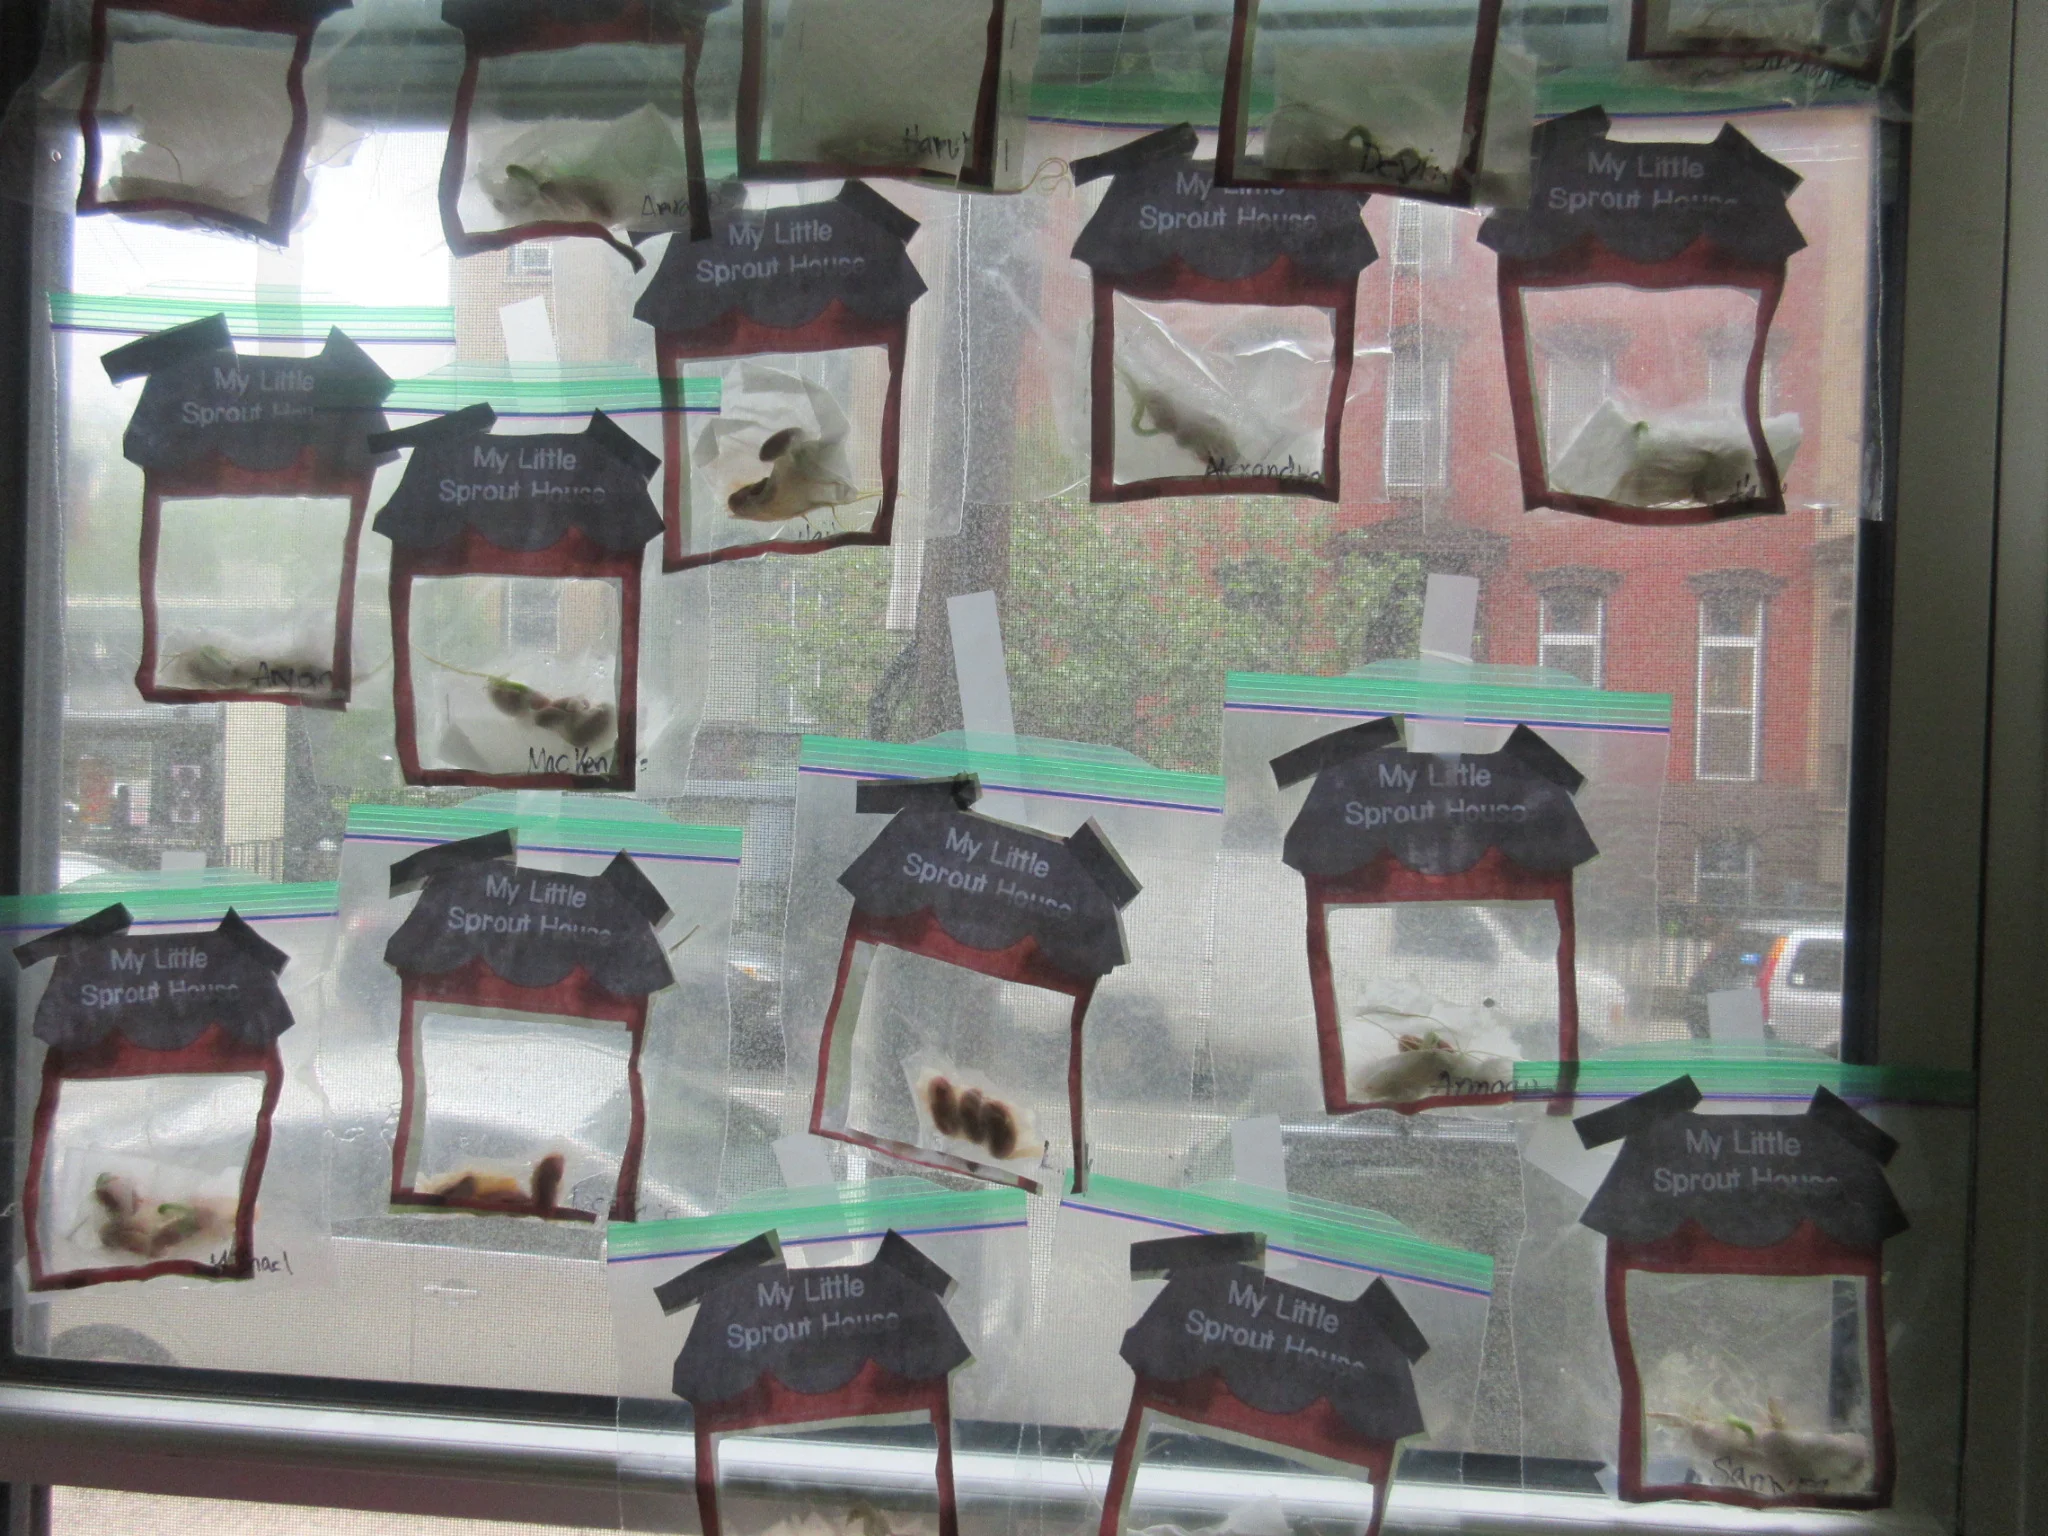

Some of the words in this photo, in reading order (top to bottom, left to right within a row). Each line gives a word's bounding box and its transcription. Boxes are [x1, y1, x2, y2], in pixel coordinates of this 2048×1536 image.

[1588, 152, 1626, 181] My
[1638, 156, 1704, 178] Little
[1176, 172, 1213, 200] My
[1549, 187, 1642, 214] Sprout
[1139, 206, 1227, 234] Sprout
[729, 222, 763, 251] My
[775, 220, 832, 244] Little
[697, 257, 779, 286] Sprout
[213, 367, 249, 397] My
[260, 370, 314, 392] Little
[182, 402, 262, 427] Sprout
[474, 446, 509, 474] My
[519, 448, 576, 470] Little
[439, 480, 520, 505] Sprout
[1379, 763, 1417, 794] My
[1428, 763, 1491, 787] Lttle
[1345, 801, 1435, 829] Sprout
[946, 827, 983, 862] My
[990, 841, 1049, 878] Little
[903, 853, 988, 892] Sprout
[486, 875, 520, 905] My
[530, 880, 586, 908] Little
[448, 906, 531, 934] Sprout
[111, 948, 145, 975] My
[155, 947, 208, 968] Little
[81, 982, 160, 1008] Sprout
[1686, 1129, 1722, 1159] My
[1734, 1130, 1801, 1156] Little
[1654, 1168, 1741, 1196] Sprout
[757, 1281, 794, 1311] My
[805, 1274, 864, 1301] Little
[1228, 1280, 1267, 1317] My
[1276, 1294, 1338, 1333] Little
[727, 1318, 811, 1350] Sprout
[1185, 1309, 1274, 1349] Sprout
